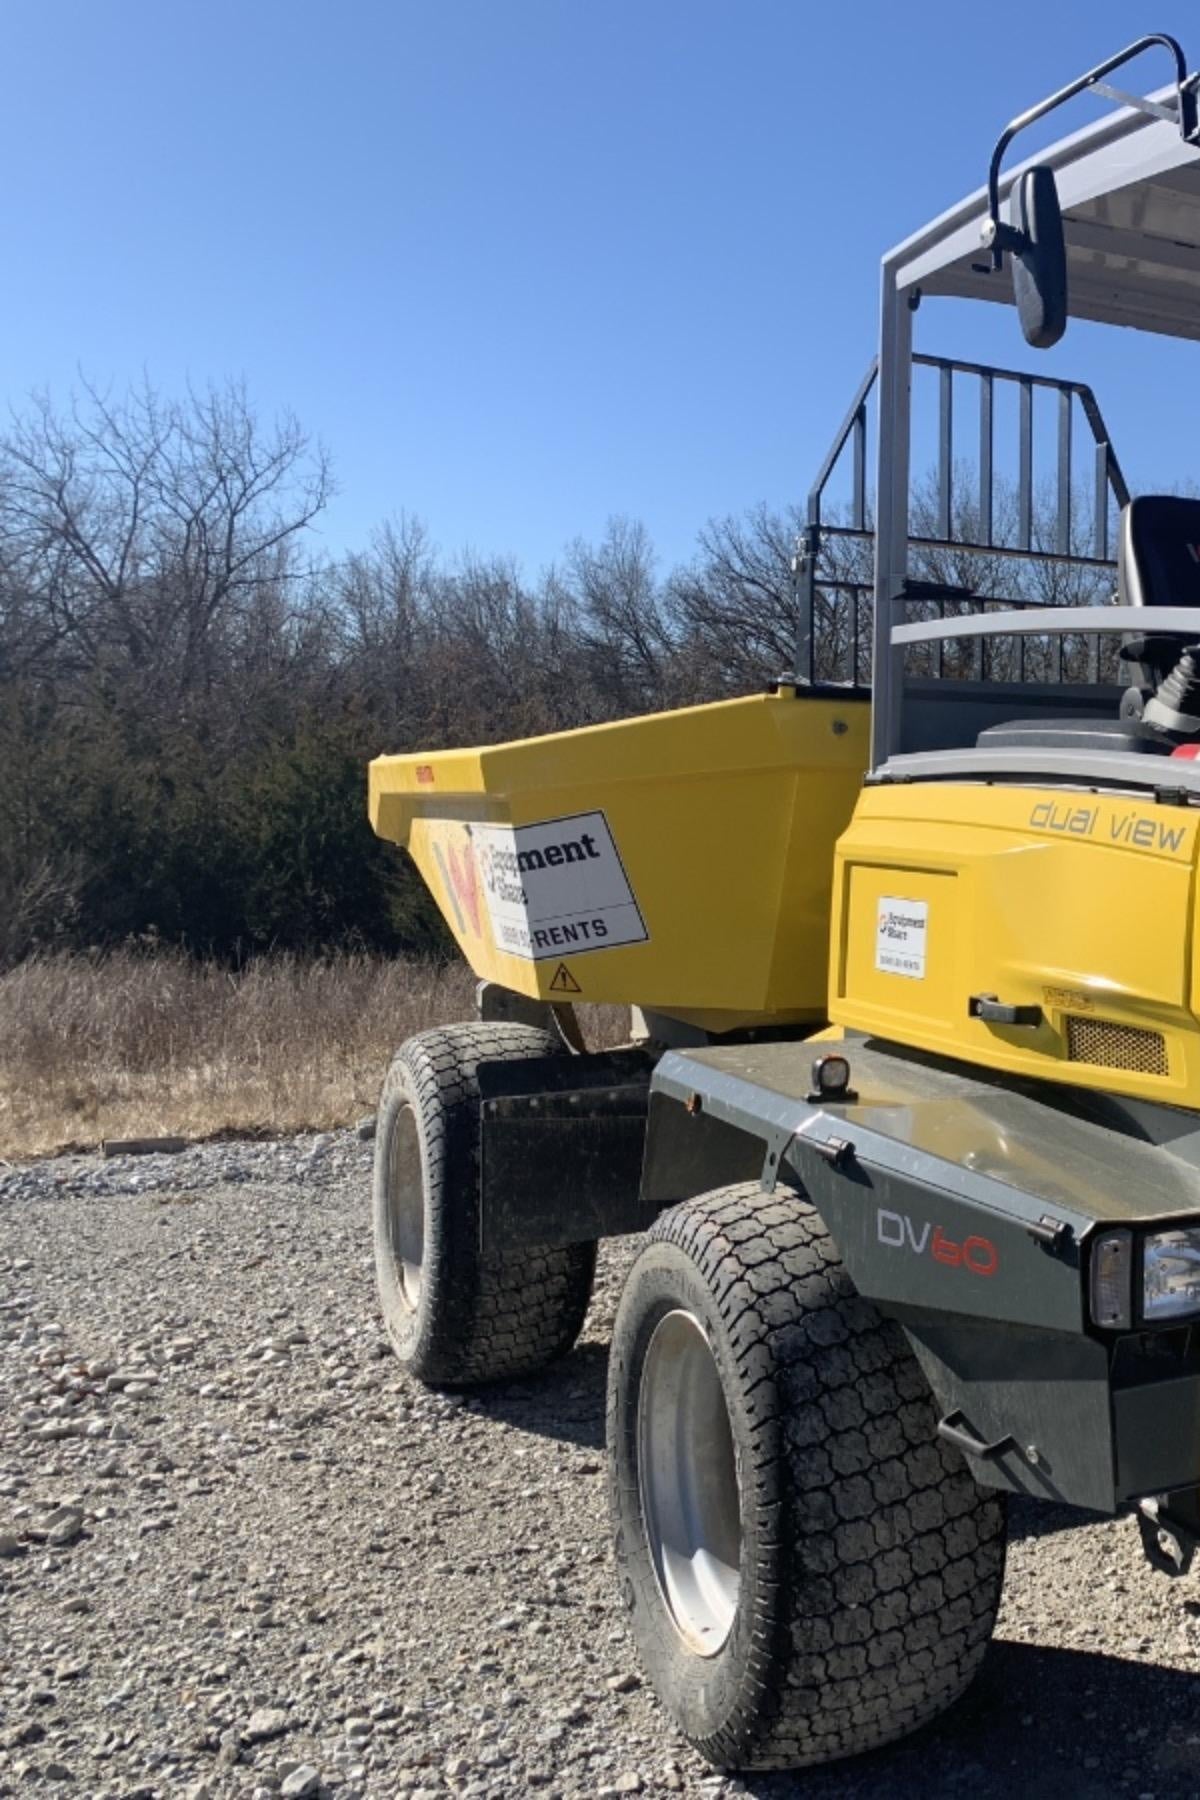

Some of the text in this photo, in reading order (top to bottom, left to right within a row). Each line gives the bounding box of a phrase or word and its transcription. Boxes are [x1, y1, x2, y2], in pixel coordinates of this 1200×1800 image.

[1029, 800, 1187, 852] dual view
[876, 1207, 999, 1277] DV60
